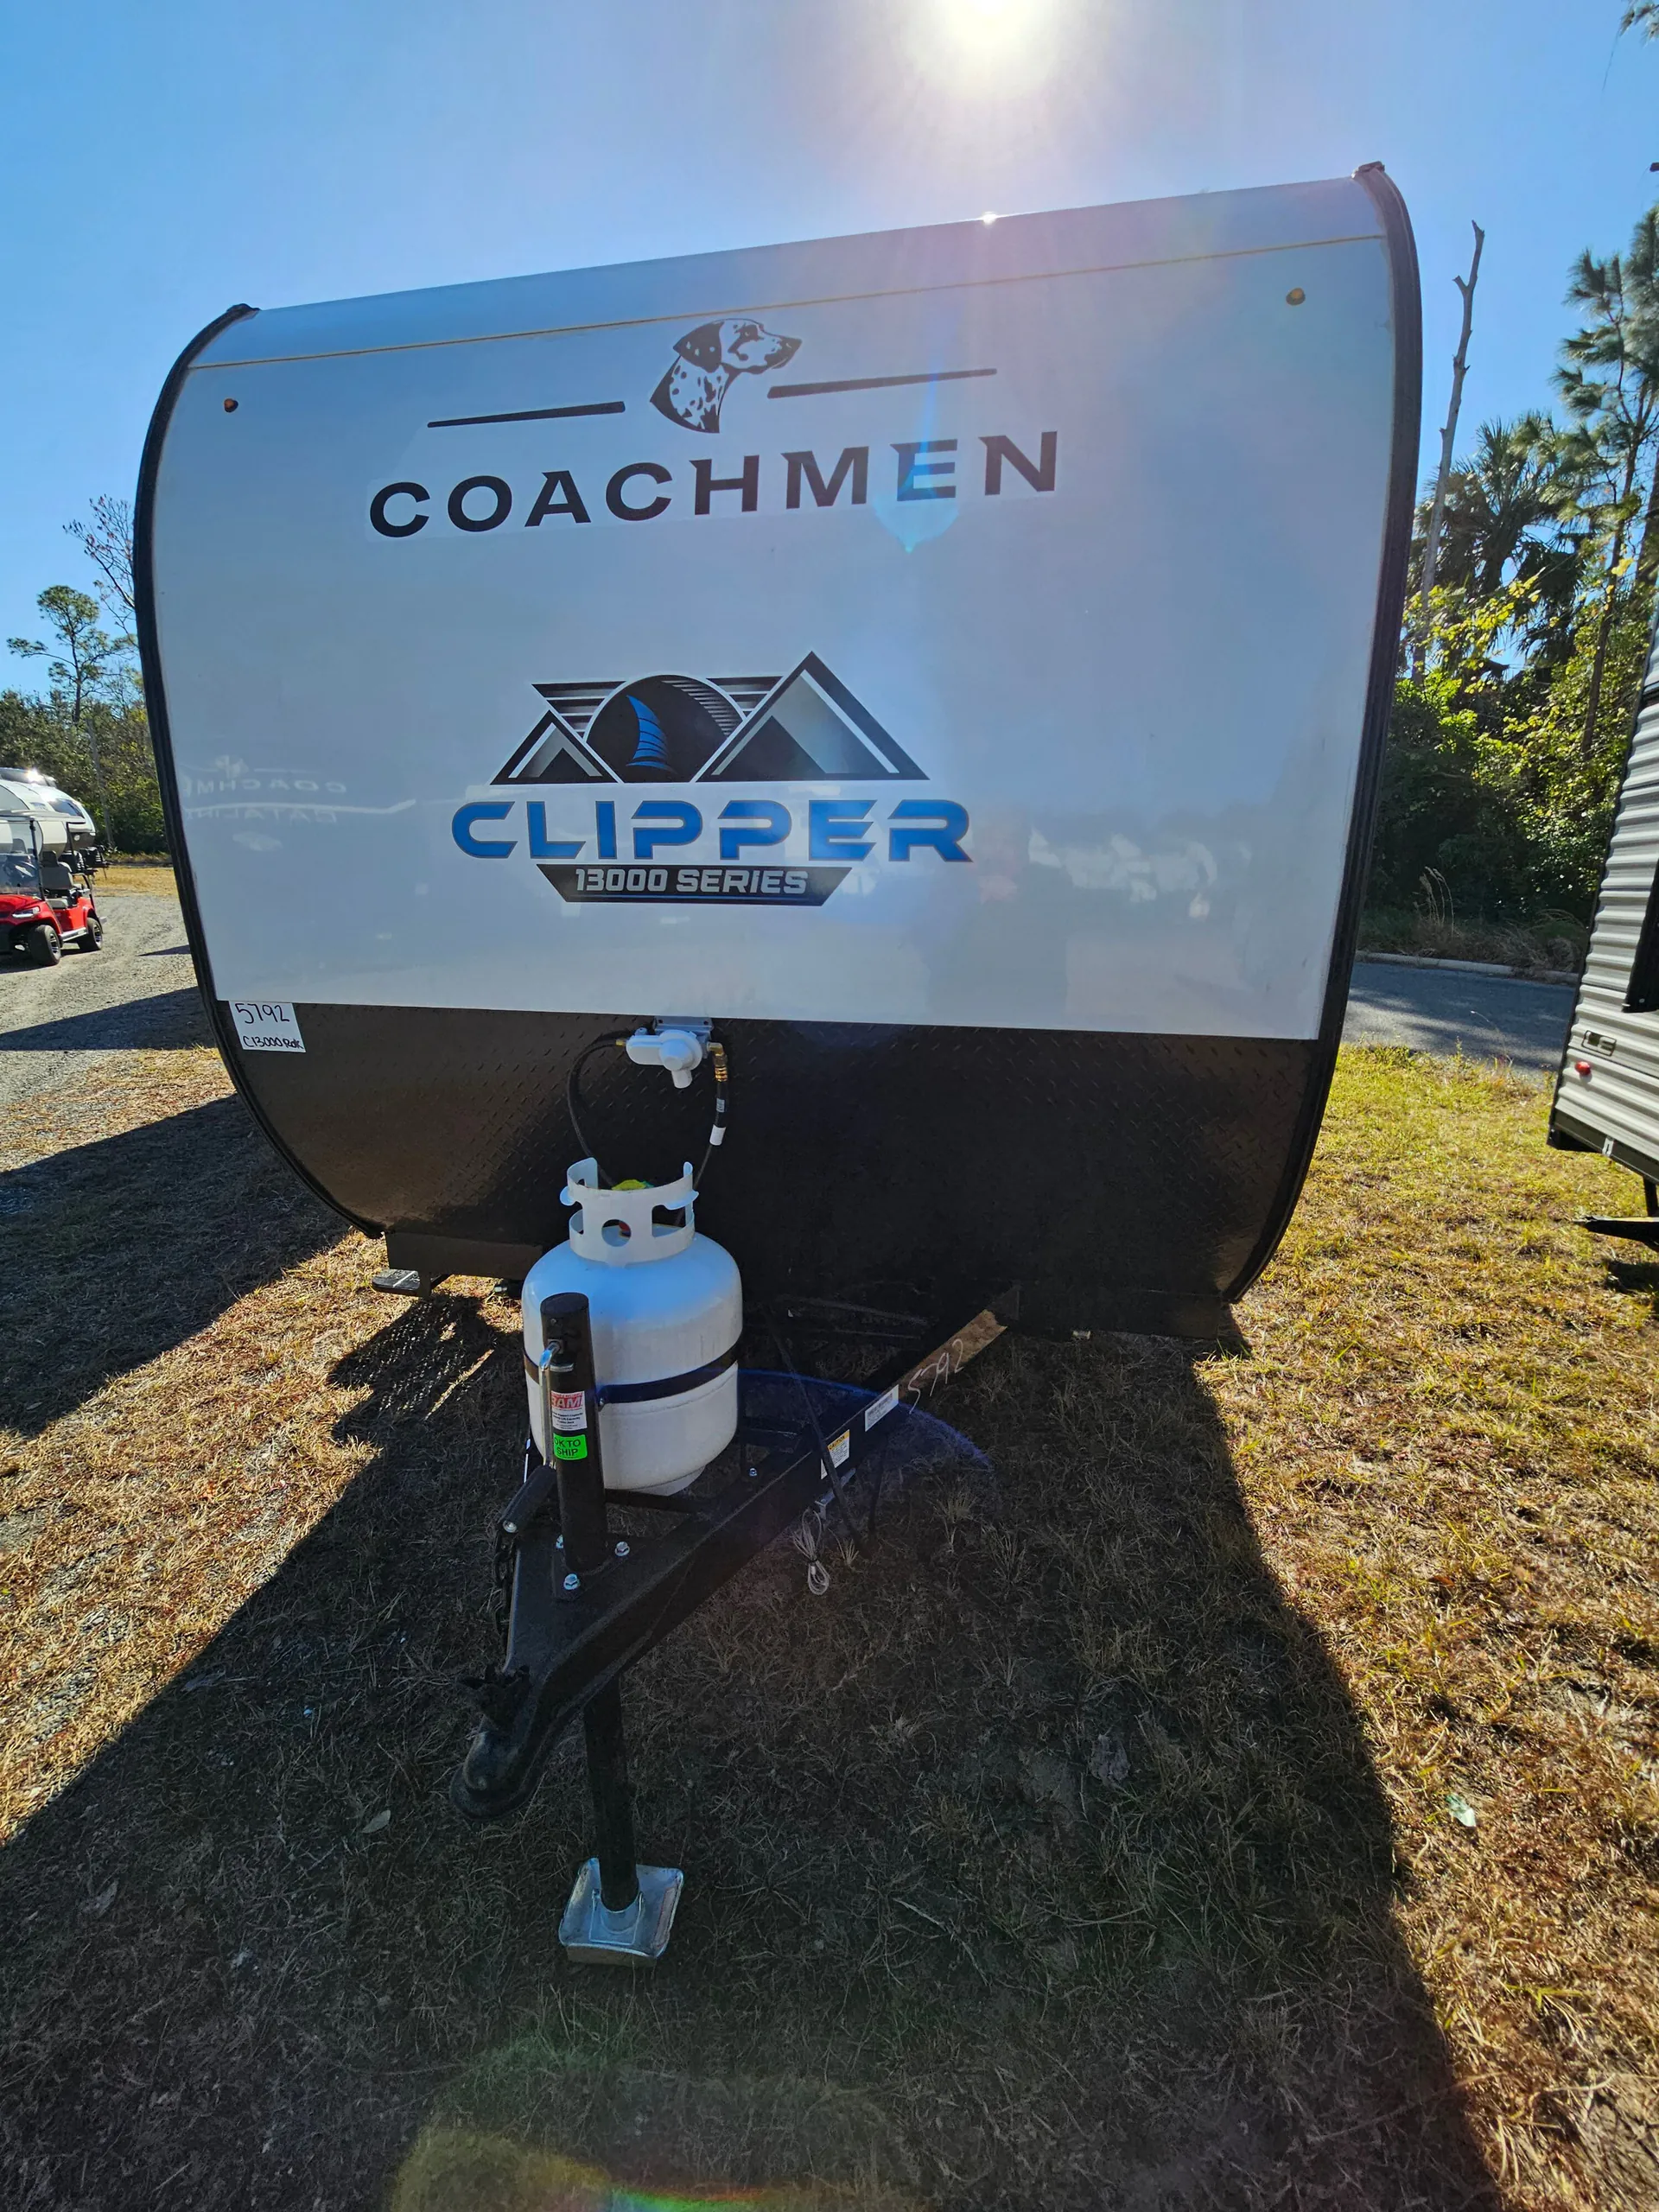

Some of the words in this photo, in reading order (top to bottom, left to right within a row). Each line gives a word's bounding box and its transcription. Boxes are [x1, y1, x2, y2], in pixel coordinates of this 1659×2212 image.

[369, 431, 1057, 537] COACHMEN
[452, 799, 975, 862] CLIPPER
[575, 868, 668, 892] 13000
[677, 869, 809, 893] SERIES
[234, 1003, 289, 1024] 5792
[907, 1338, 964, 1414] 5792
[556, 1446, 578, 1457] SHIP
[567, 1439, 581, 1448] TO
